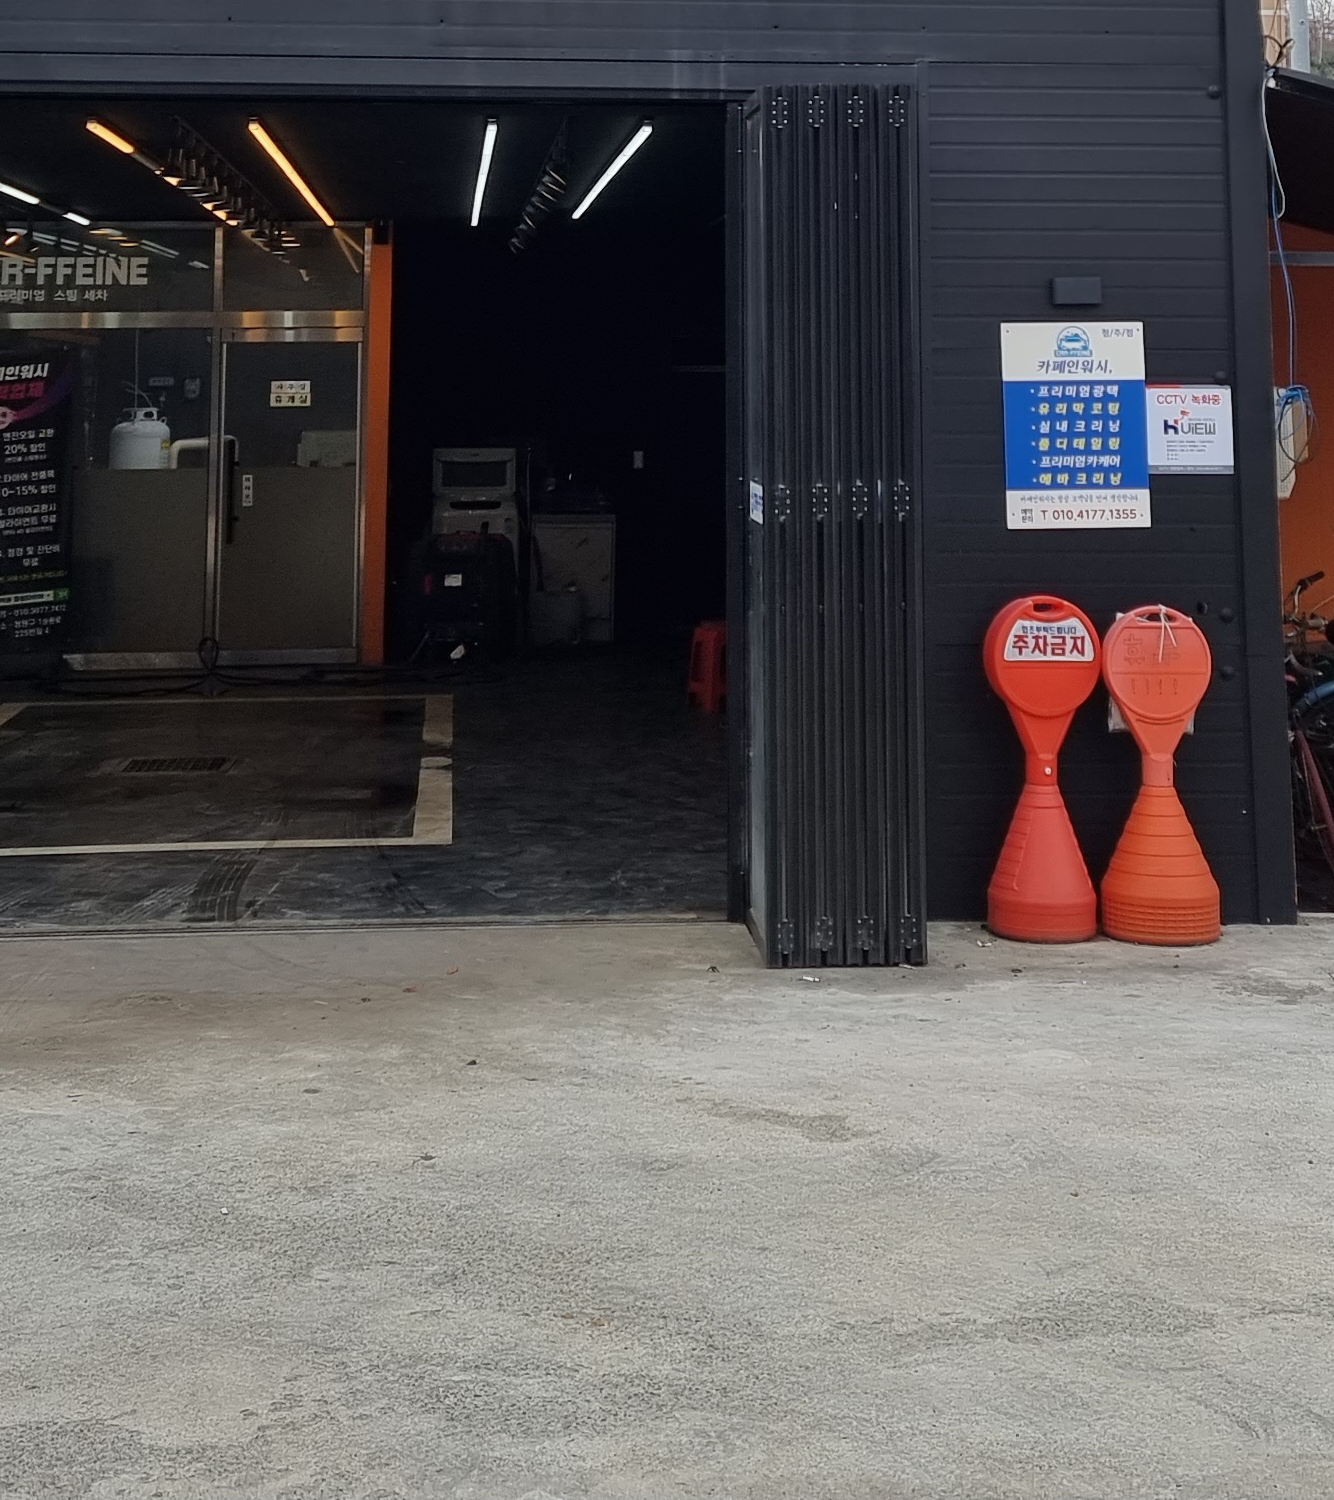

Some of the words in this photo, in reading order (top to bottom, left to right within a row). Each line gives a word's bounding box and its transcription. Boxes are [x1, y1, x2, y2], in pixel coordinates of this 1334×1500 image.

[83, 289, 108, 302] 세차
[1037, 384, 1119, 398] 프리미엄광택
[274, 394, 308, 405] 휴게실
[1156, 394, 1187, 405] CCTV
[1191, 394, 1221, 406] 녹화중
[4, 443, 28, 455] 20%
[1040, 455, 1121, 468] 프리미엄카케어
[1040, 509, 1049, 521] T
[1052, 508, 1137, 522] 010.4177.1355
[1012, 634, 1086, 657] 주차금지
